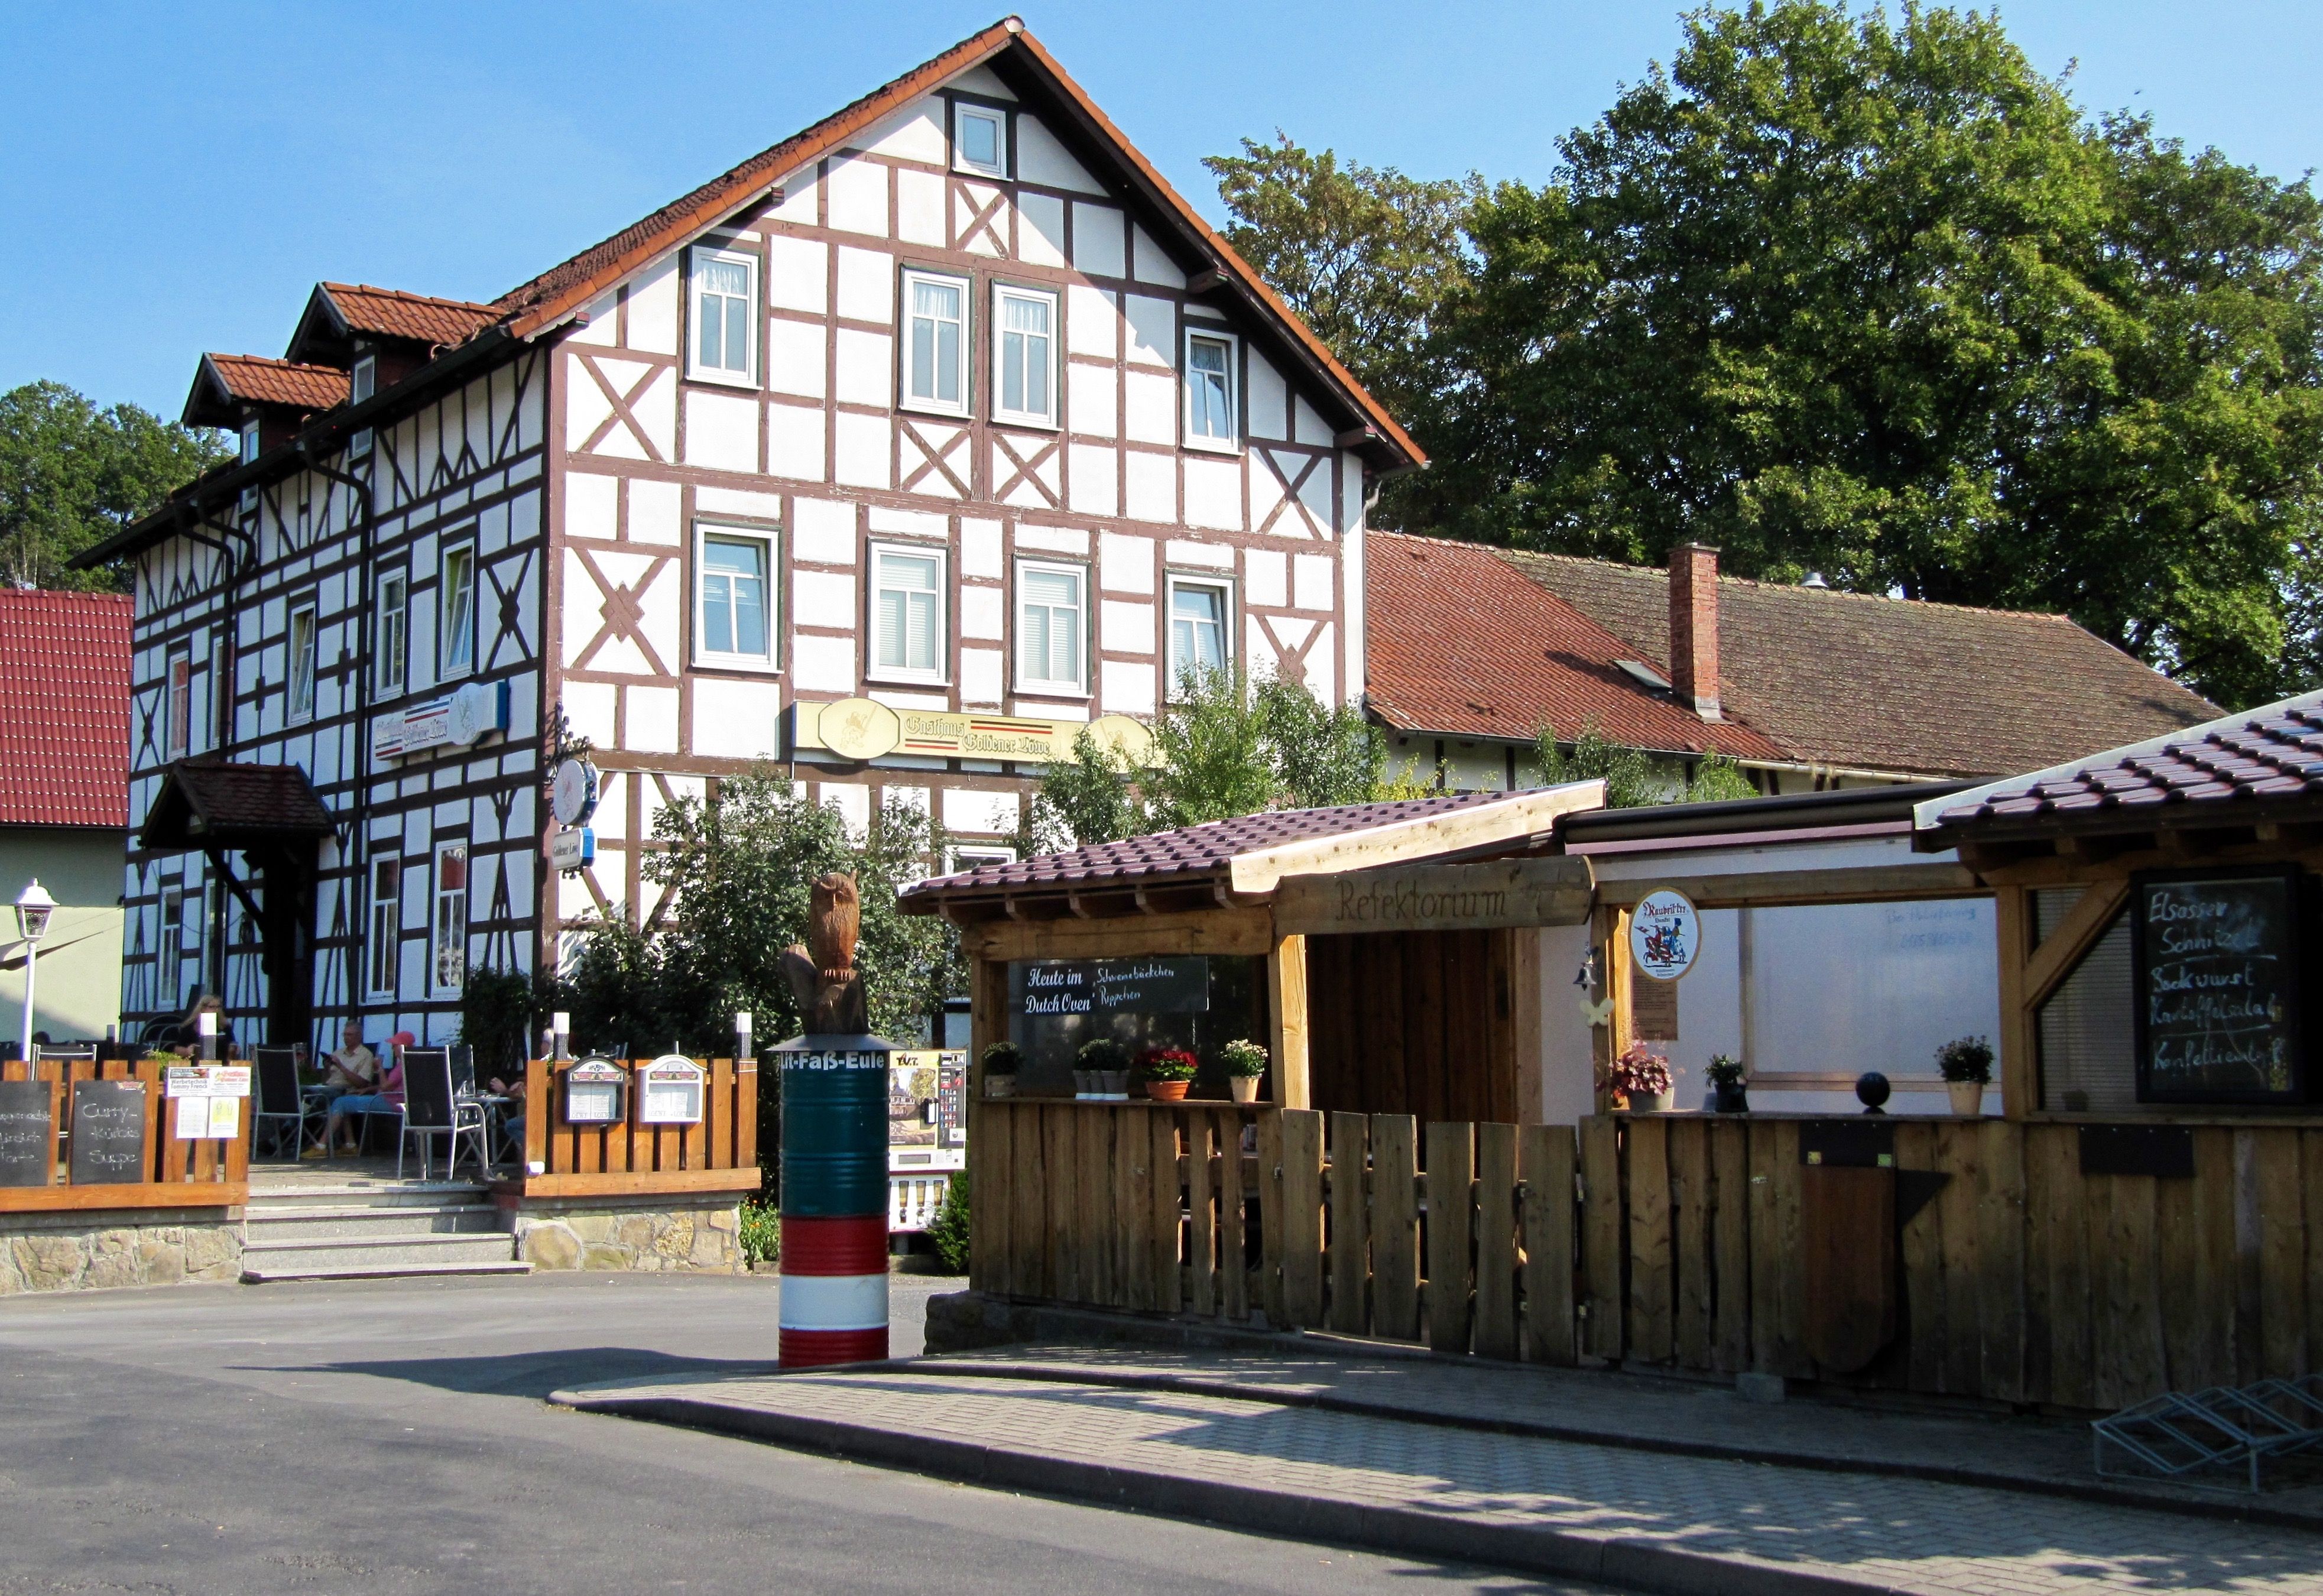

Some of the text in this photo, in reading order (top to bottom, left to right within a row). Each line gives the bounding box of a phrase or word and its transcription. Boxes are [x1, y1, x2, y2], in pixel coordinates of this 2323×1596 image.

[905, 716, 965, 738] Gasthaus
[962, 733, 1050, 755] Goldener Löwe
[1335, 880, 1506, 921] Refektorium
[1643, 901, 1686, 917] Raubritter
[1028, 968, 1083, 987] Heute im
[1026, 993, 1091, 1013] Dutch Oven
[1099, 985, 1141, 1007] Rippchen
[90, 1150, 138, 1171] Suppe
